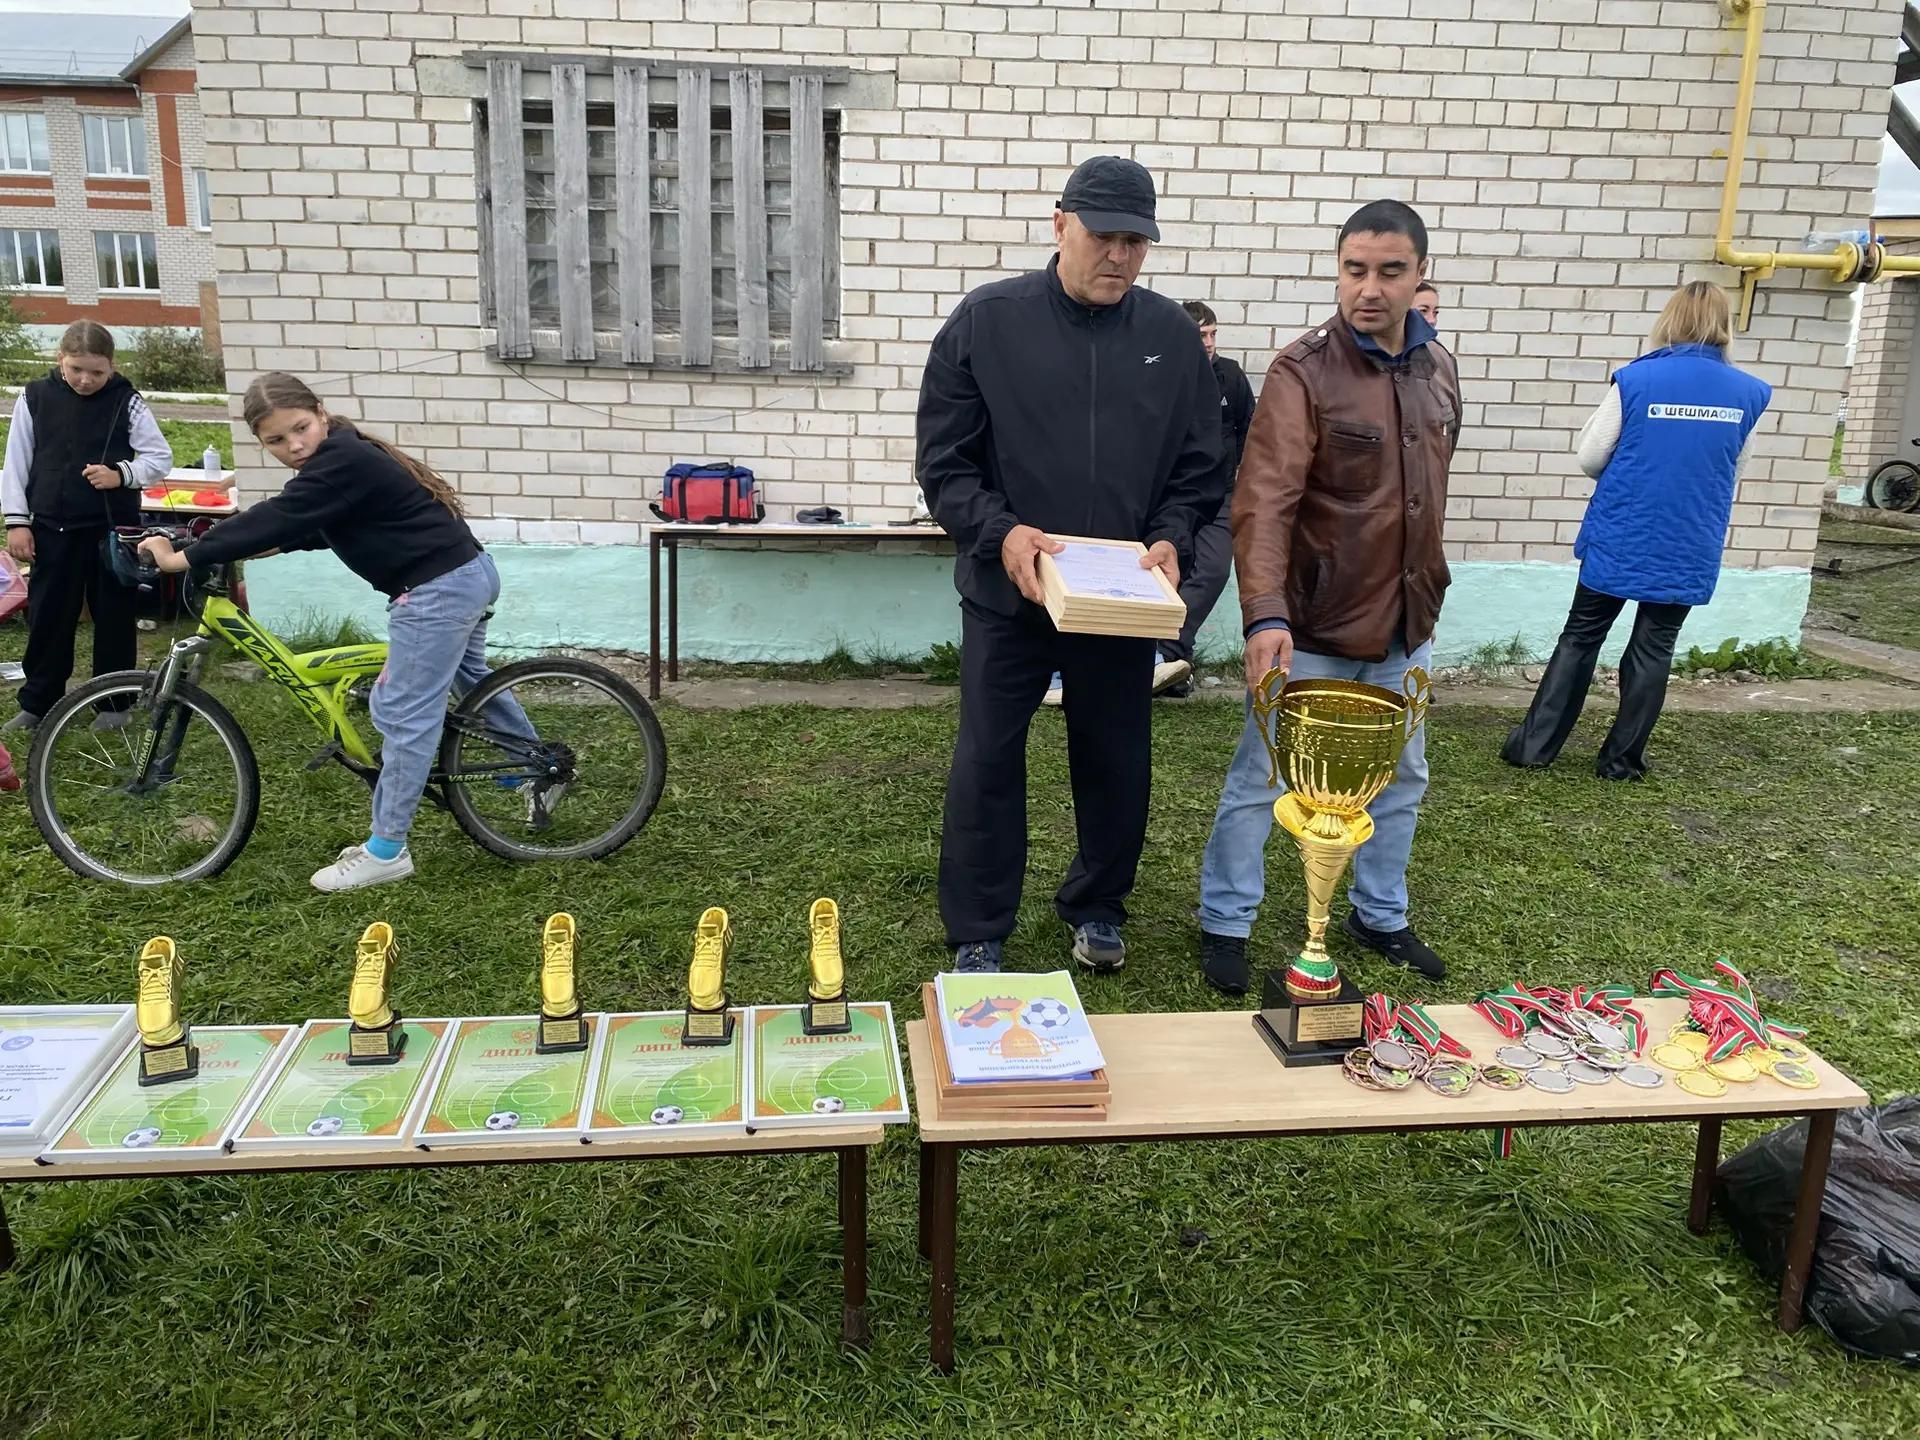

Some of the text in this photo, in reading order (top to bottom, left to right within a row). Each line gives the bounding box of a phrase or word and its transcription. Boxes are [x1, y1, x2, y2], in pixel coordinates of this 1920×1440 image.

[241, 635, 322, 713] VARMA
[448, 773, 494, 783] VARMA
[783, 1034, 865, 1046] ДИПЛОМ
[480, 1047, 535, 1058] ДИПЛ
